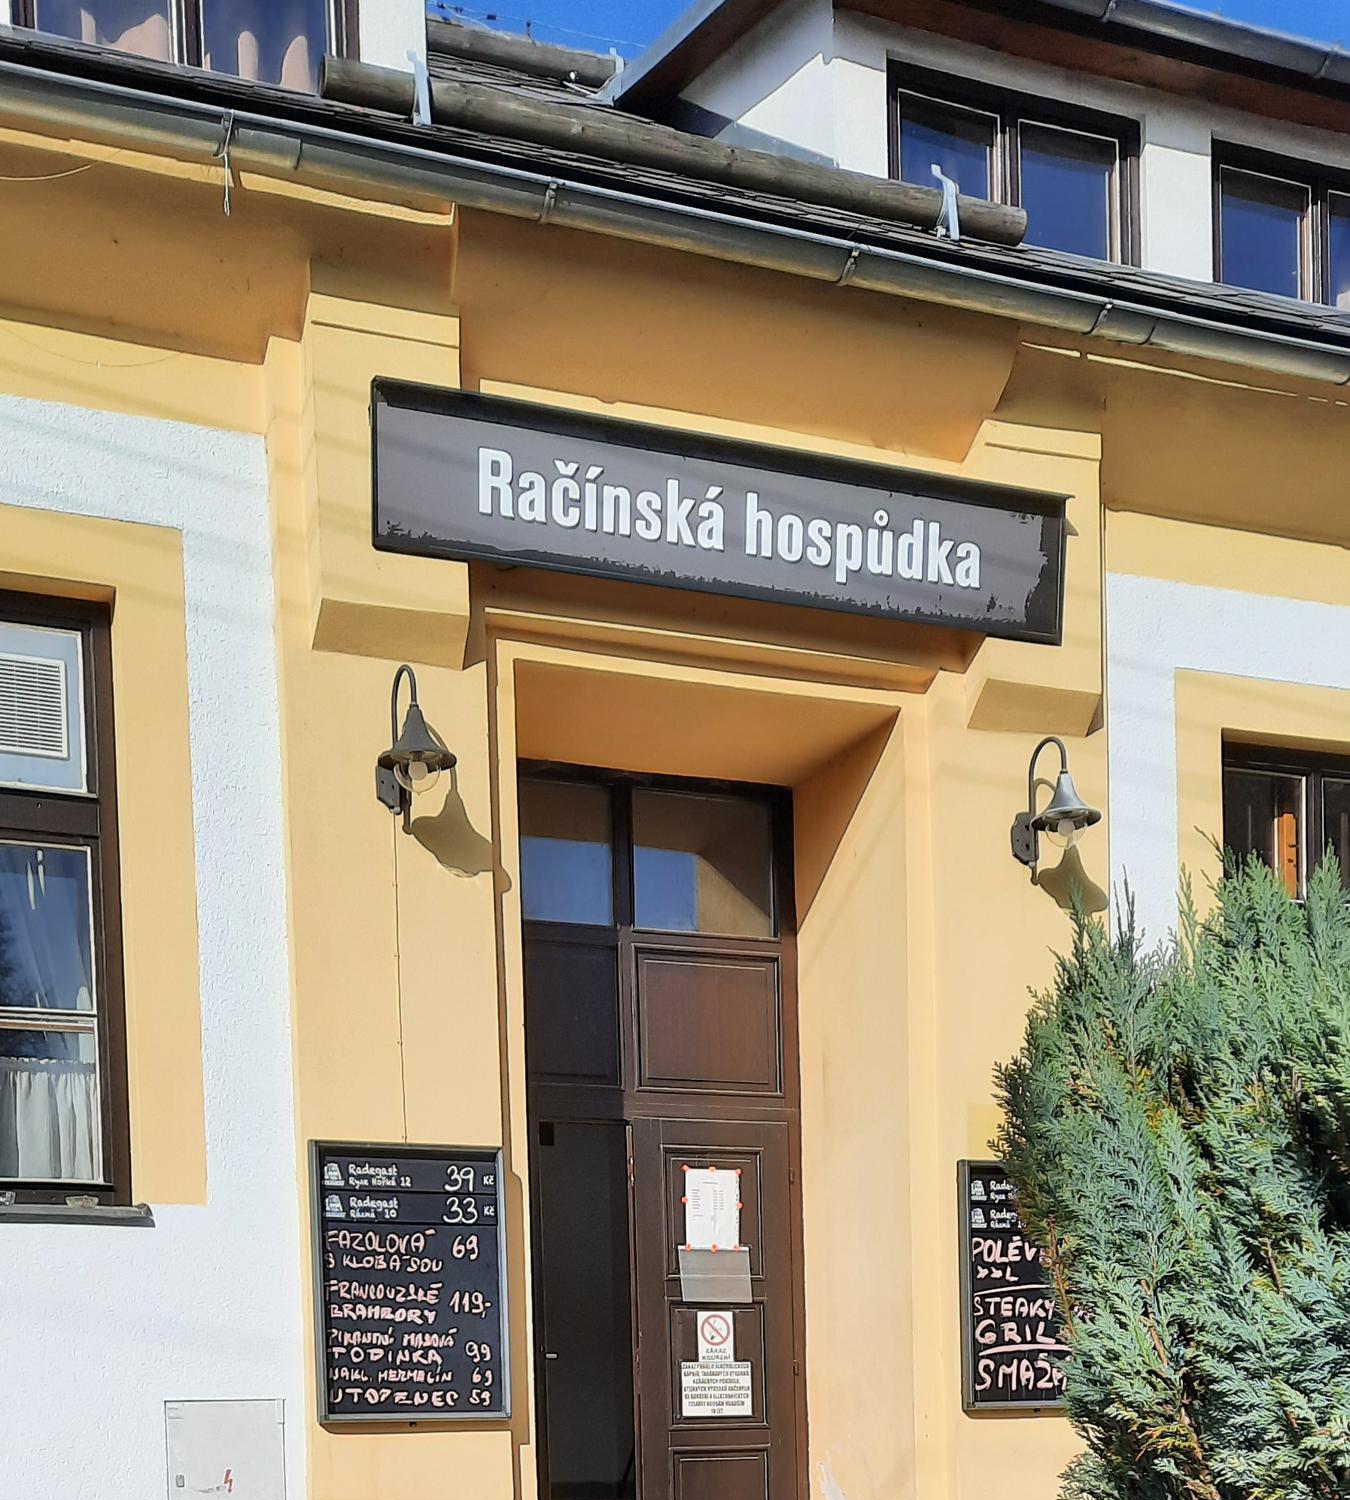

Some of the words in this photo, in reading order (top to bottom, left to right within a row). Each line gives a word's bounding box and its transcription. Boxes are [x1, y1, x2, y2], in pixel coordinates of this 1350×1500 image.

[477, 446, 726, 552] Račínská
[745, 491, 982, 589] hospůdka
[349, 1163, 397, 1178] Radegast
[444, 1165, 475, 1192] 39
[483, 1175, 495, 1186] Kč
[400, 1176, 411, 1187] 12
[350, 1195, 399, 1212] Radegast
[443, 1197, 478, 1224] 33
[484, 1205, 495, 1216] Kč
[384, 1208, 398, 1219] 10
[325, 1229, 436, 1254] FAZOLOVÁ
[452, 1235, 479, 1260] 69
[342, 1253, 443, 1273] KLOBÁSOU
[328, 1303, 438, 1325] BRAMBORY
[973, 1296, 1055, 1320] STEAKY
[465, 1341, 492, 1363] 99
[472, 1366, 493, 1386] 69
[469, 1389, 492, 1406] 59
